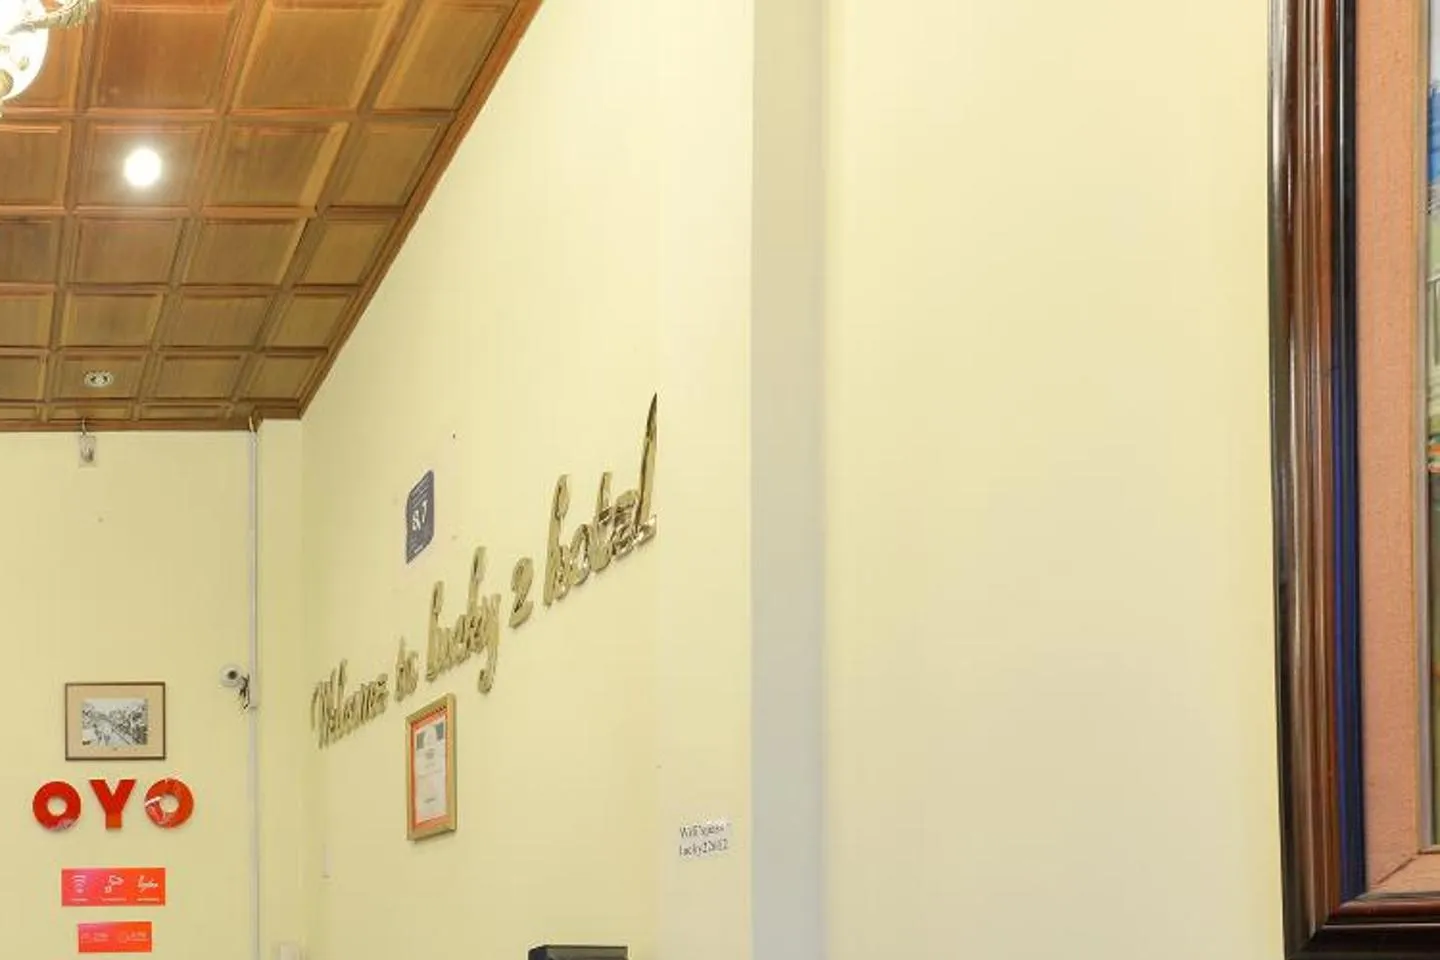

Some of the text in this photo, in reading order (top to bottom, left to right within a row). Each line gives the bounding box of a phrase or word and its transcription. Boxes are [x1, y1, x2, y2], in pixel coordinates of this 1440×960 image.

[394, 636, 420, 703] to
[509, 558, 534, 629] 2
[32, 777, 195, 830] OYO
